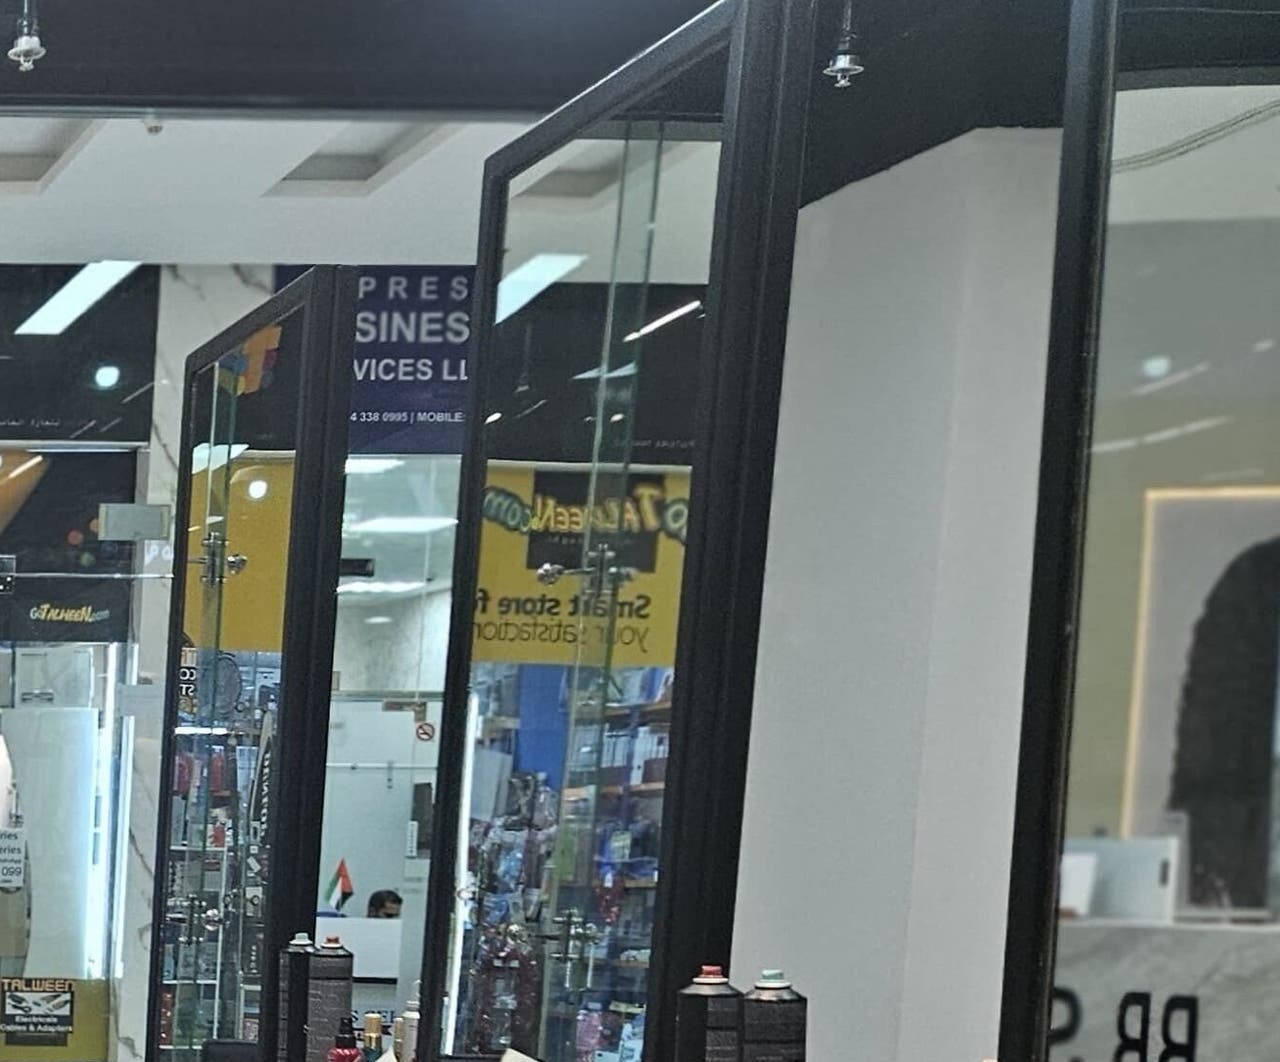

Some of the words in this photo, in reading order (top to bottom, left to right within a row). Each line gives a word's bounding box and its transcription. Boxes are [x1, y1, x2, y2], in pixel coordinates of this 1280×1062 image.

[355, 311, 472, 343] SINES
[353, 358, 434, 381] VICES
[360, 412, 380, 422] 338
[1, 978, 74, 992] TALWEEN
